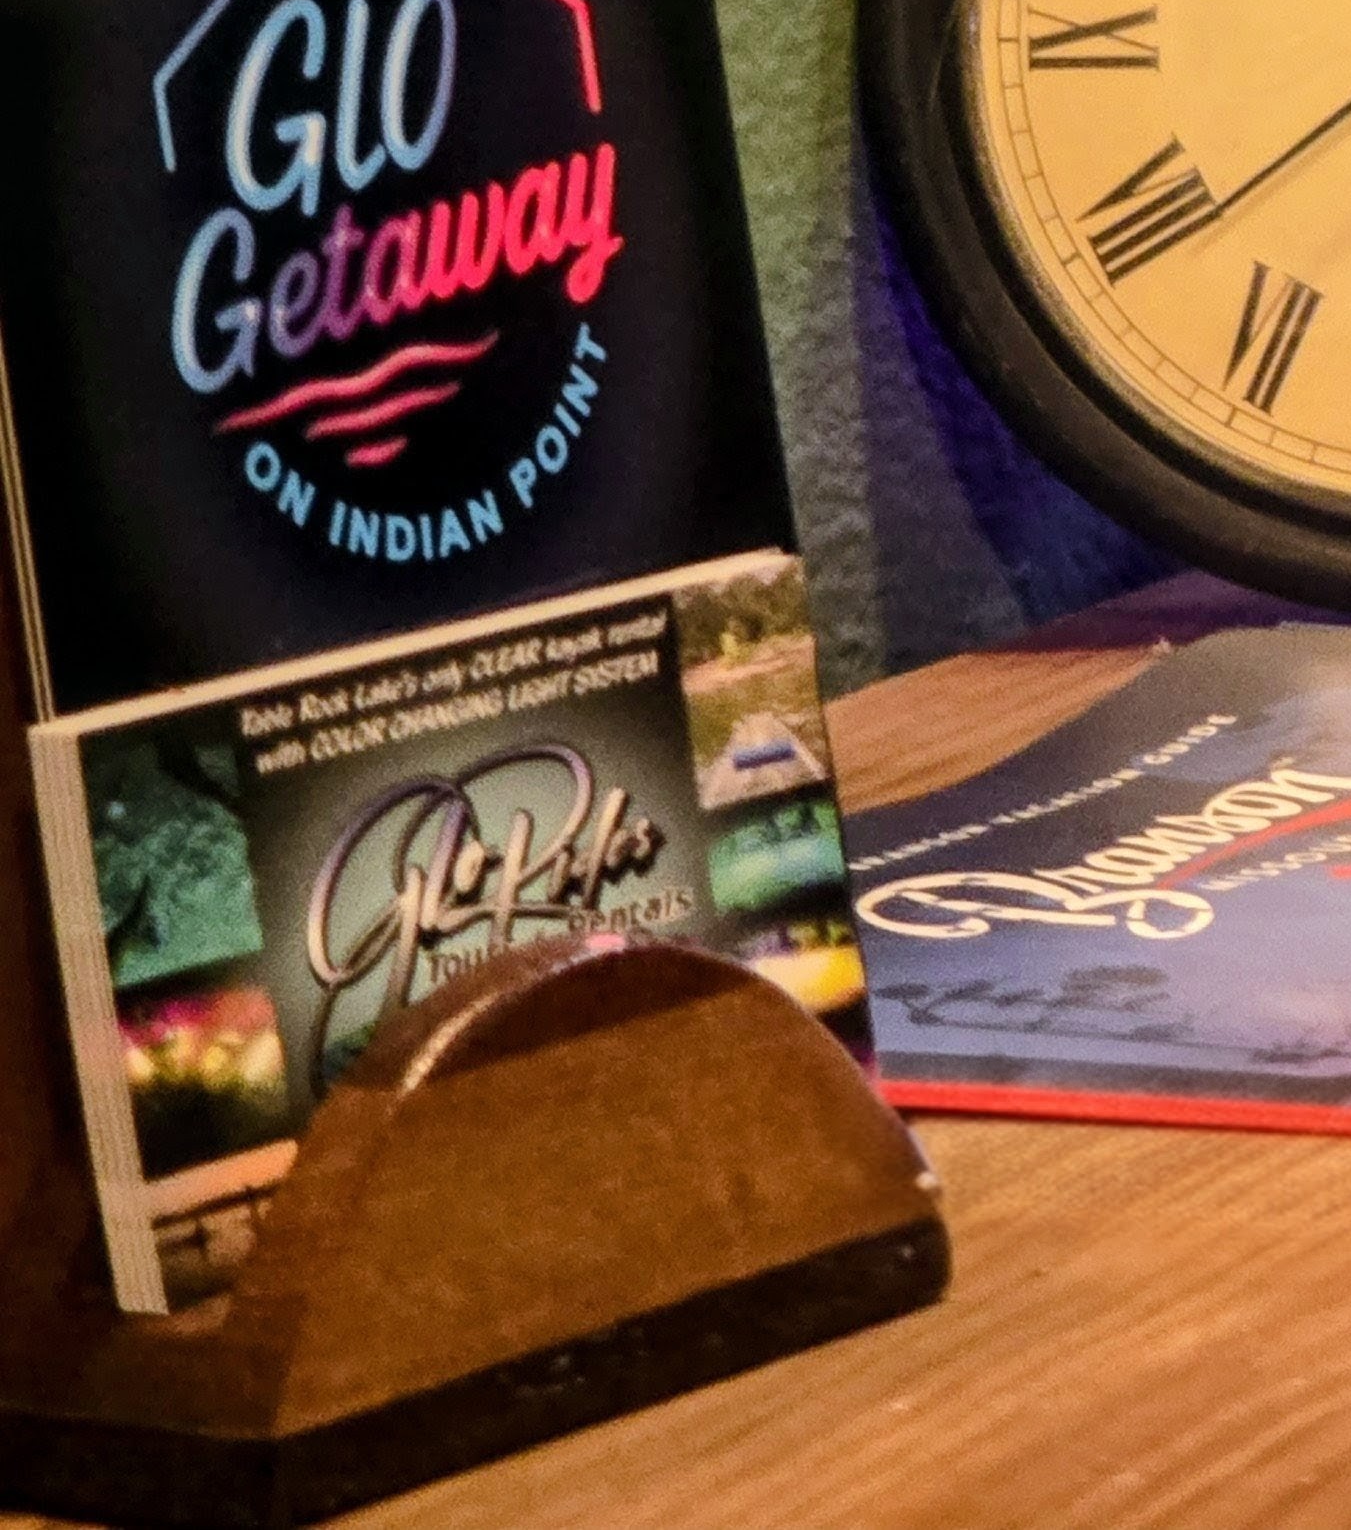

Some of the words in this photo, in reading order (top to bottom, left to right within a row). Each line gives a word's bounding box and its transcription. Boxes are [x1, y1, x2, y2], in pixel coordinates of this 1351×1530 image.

[1026, 3, 1161, 72] IX
[170, 142, 625, 395] Getaway
[1220, 259, 1325, 417] VII
[243, 439, 317, 527] ON
[328, 488, 504, 563] INDIAN
[507, 321, 608, 509] POINT
